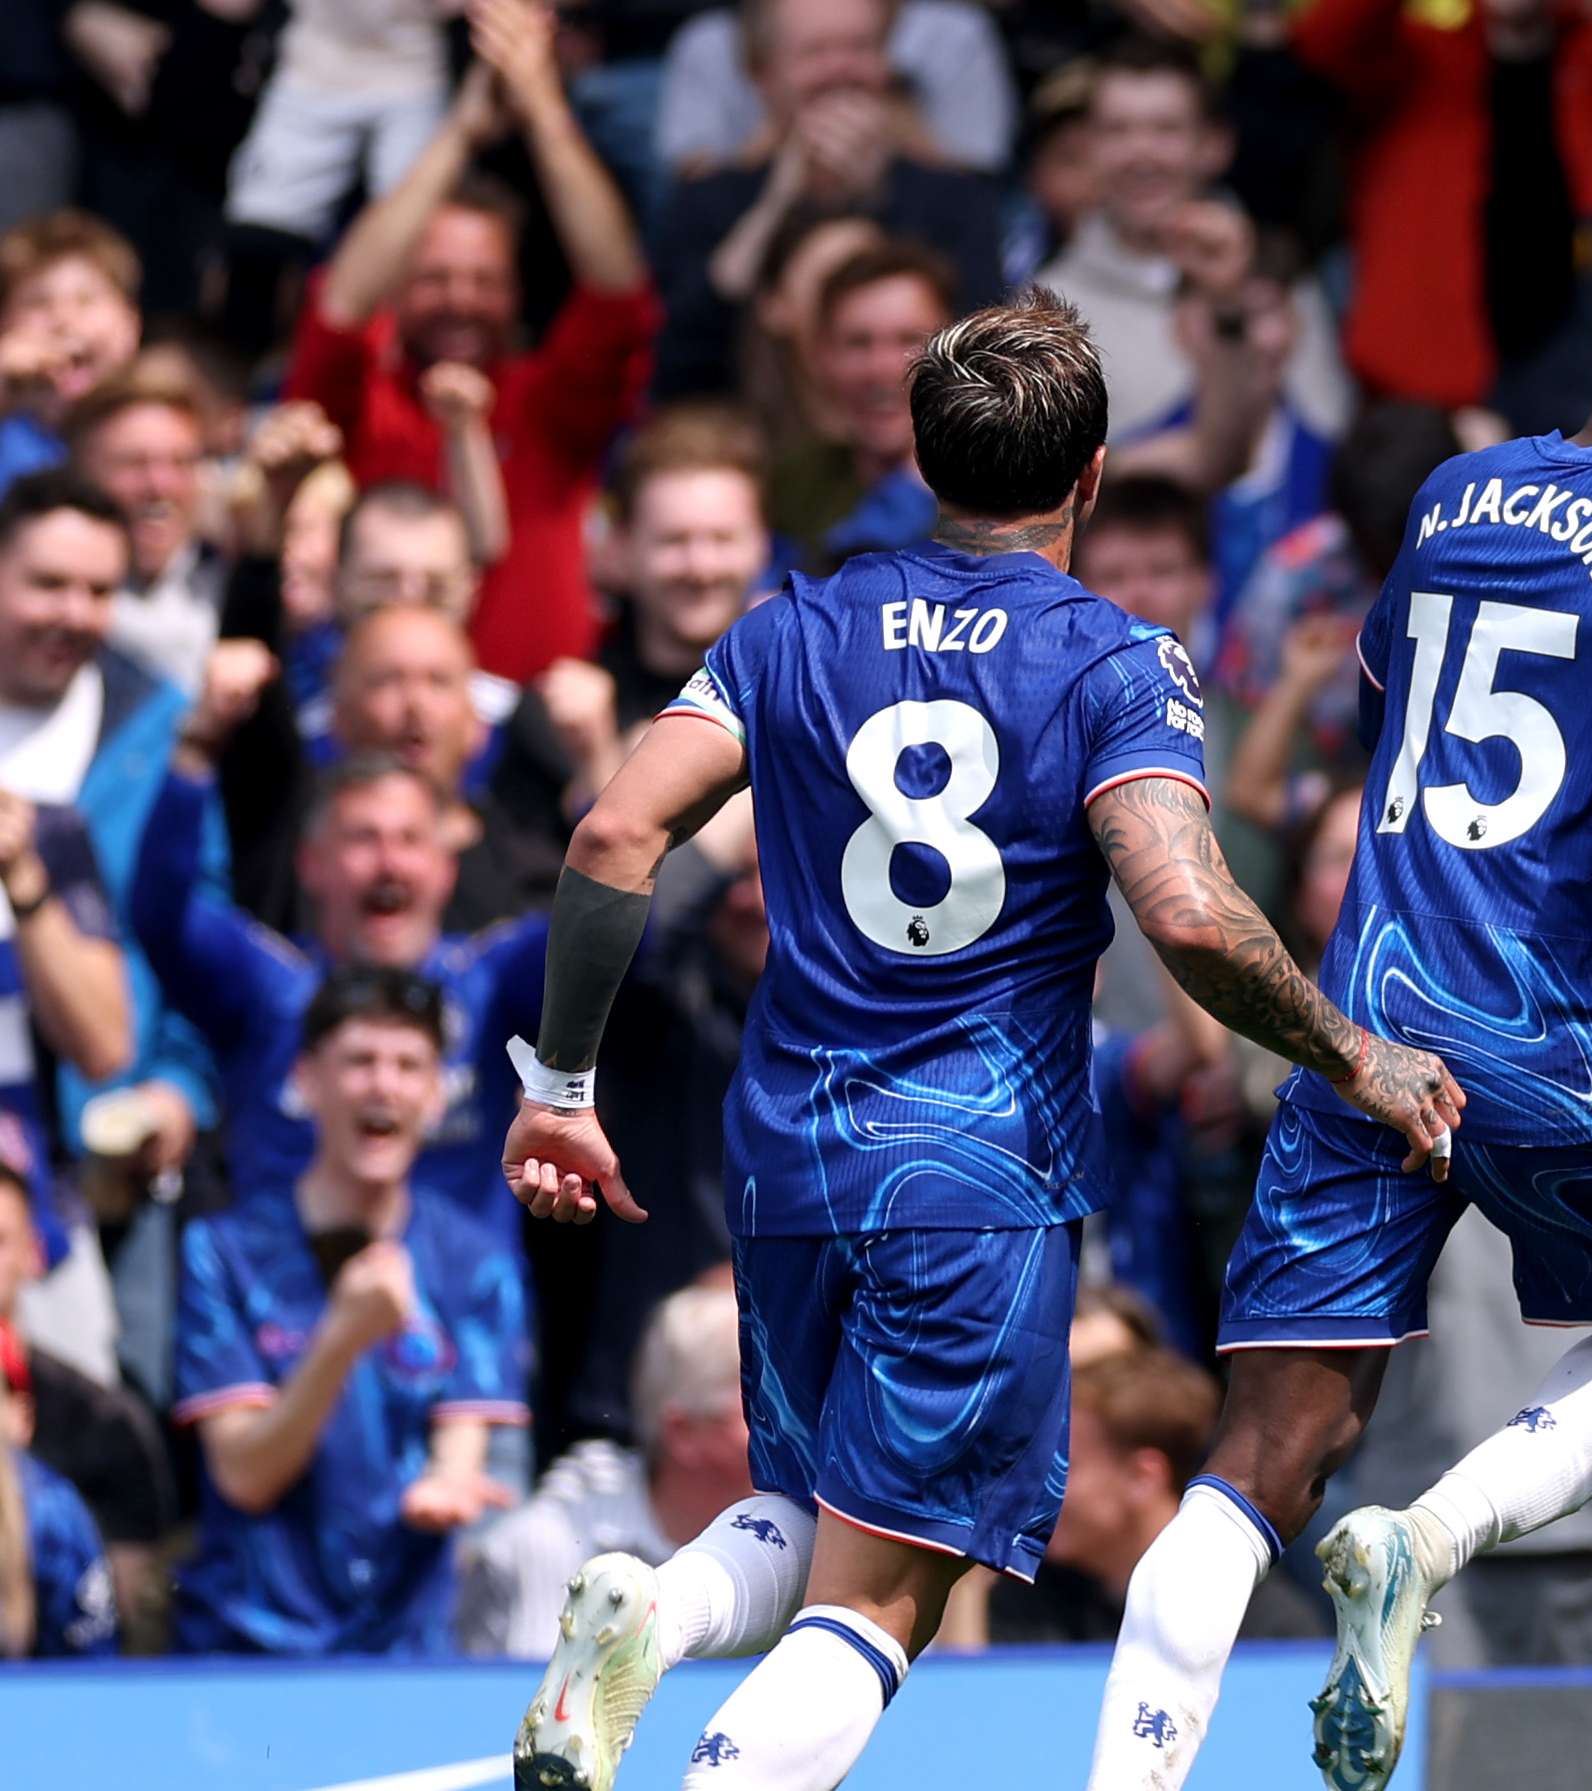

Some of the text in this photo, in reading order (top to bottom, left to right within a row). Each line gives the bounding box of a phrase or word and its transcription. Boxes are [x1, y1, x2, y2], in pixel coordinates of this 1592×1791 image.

[882, 598, 1008, 655] ENZO
[1376, 592, 1580, 850] 15
[841, 699, 1006, 956] 8
